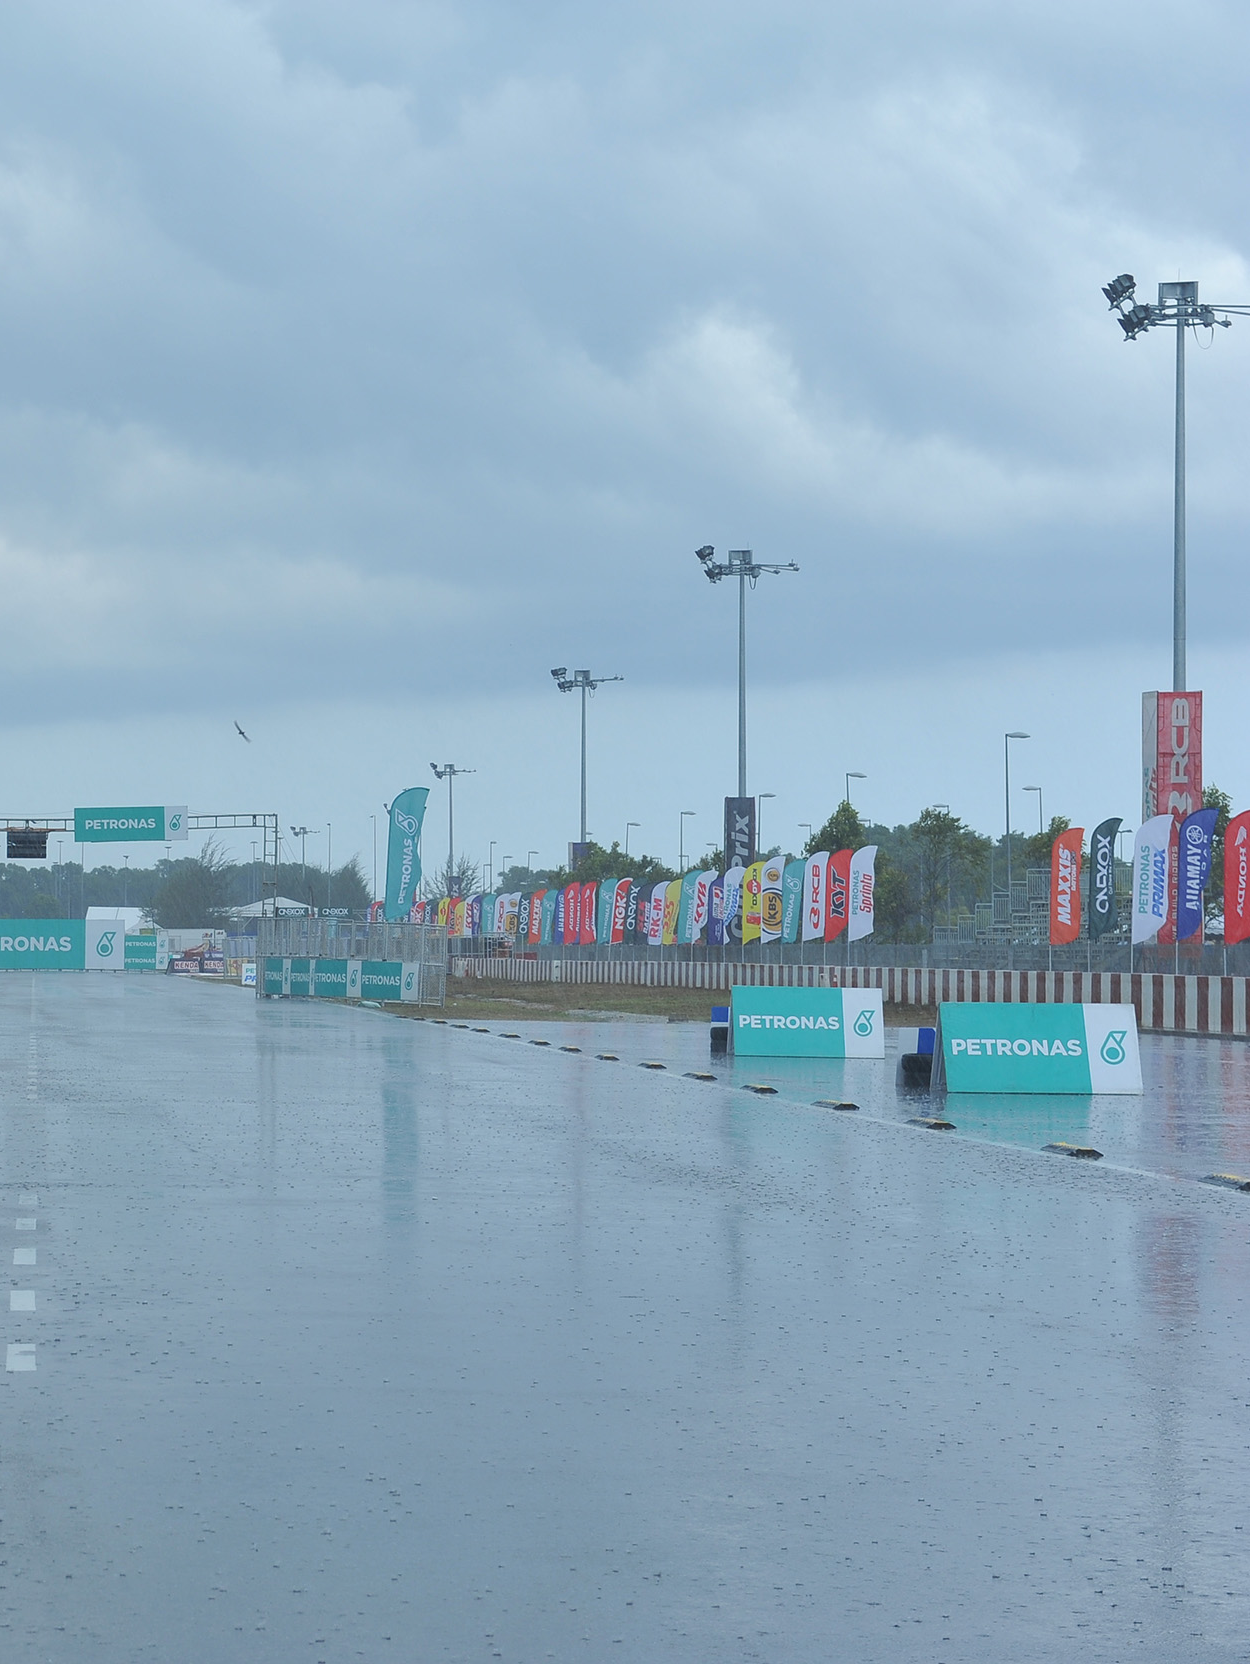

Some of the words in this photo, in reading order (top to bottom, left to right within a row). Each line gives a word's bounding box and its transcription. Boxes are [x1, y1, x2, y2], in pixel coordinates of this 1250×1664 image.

[1171, 698, 1189, 784] RCB
[85, 818, 156, 830] PETRONAS
[398, 838, 413, 904] PETRONAS
[812, 864, 820, 903] RCB
[1057, 846, 1071, 926] MAXXIS
[1138, 845, 1150, 914] PETRONAS
[1151, 848, 1166, 918] PRIMAX
[768, 896, 779, 920] KBS
[830, 865, 846, 918] KYT
[859, 873, 873, 913] Sprinta
[532, 897, 541, 935] MAXXIS
[615, 896, 626, 930] NGK
[685, 900, 694, 938] PETRONAS
[783, 893, 795, 938] PETRONAS
[174, 961, 199, 970] KENDA
[362, 975, 400, 986] PETRONAS
[738, 1015, 840, 1030] PETRONAS
[951, 1039, 1083, 1057] PETRONAS
